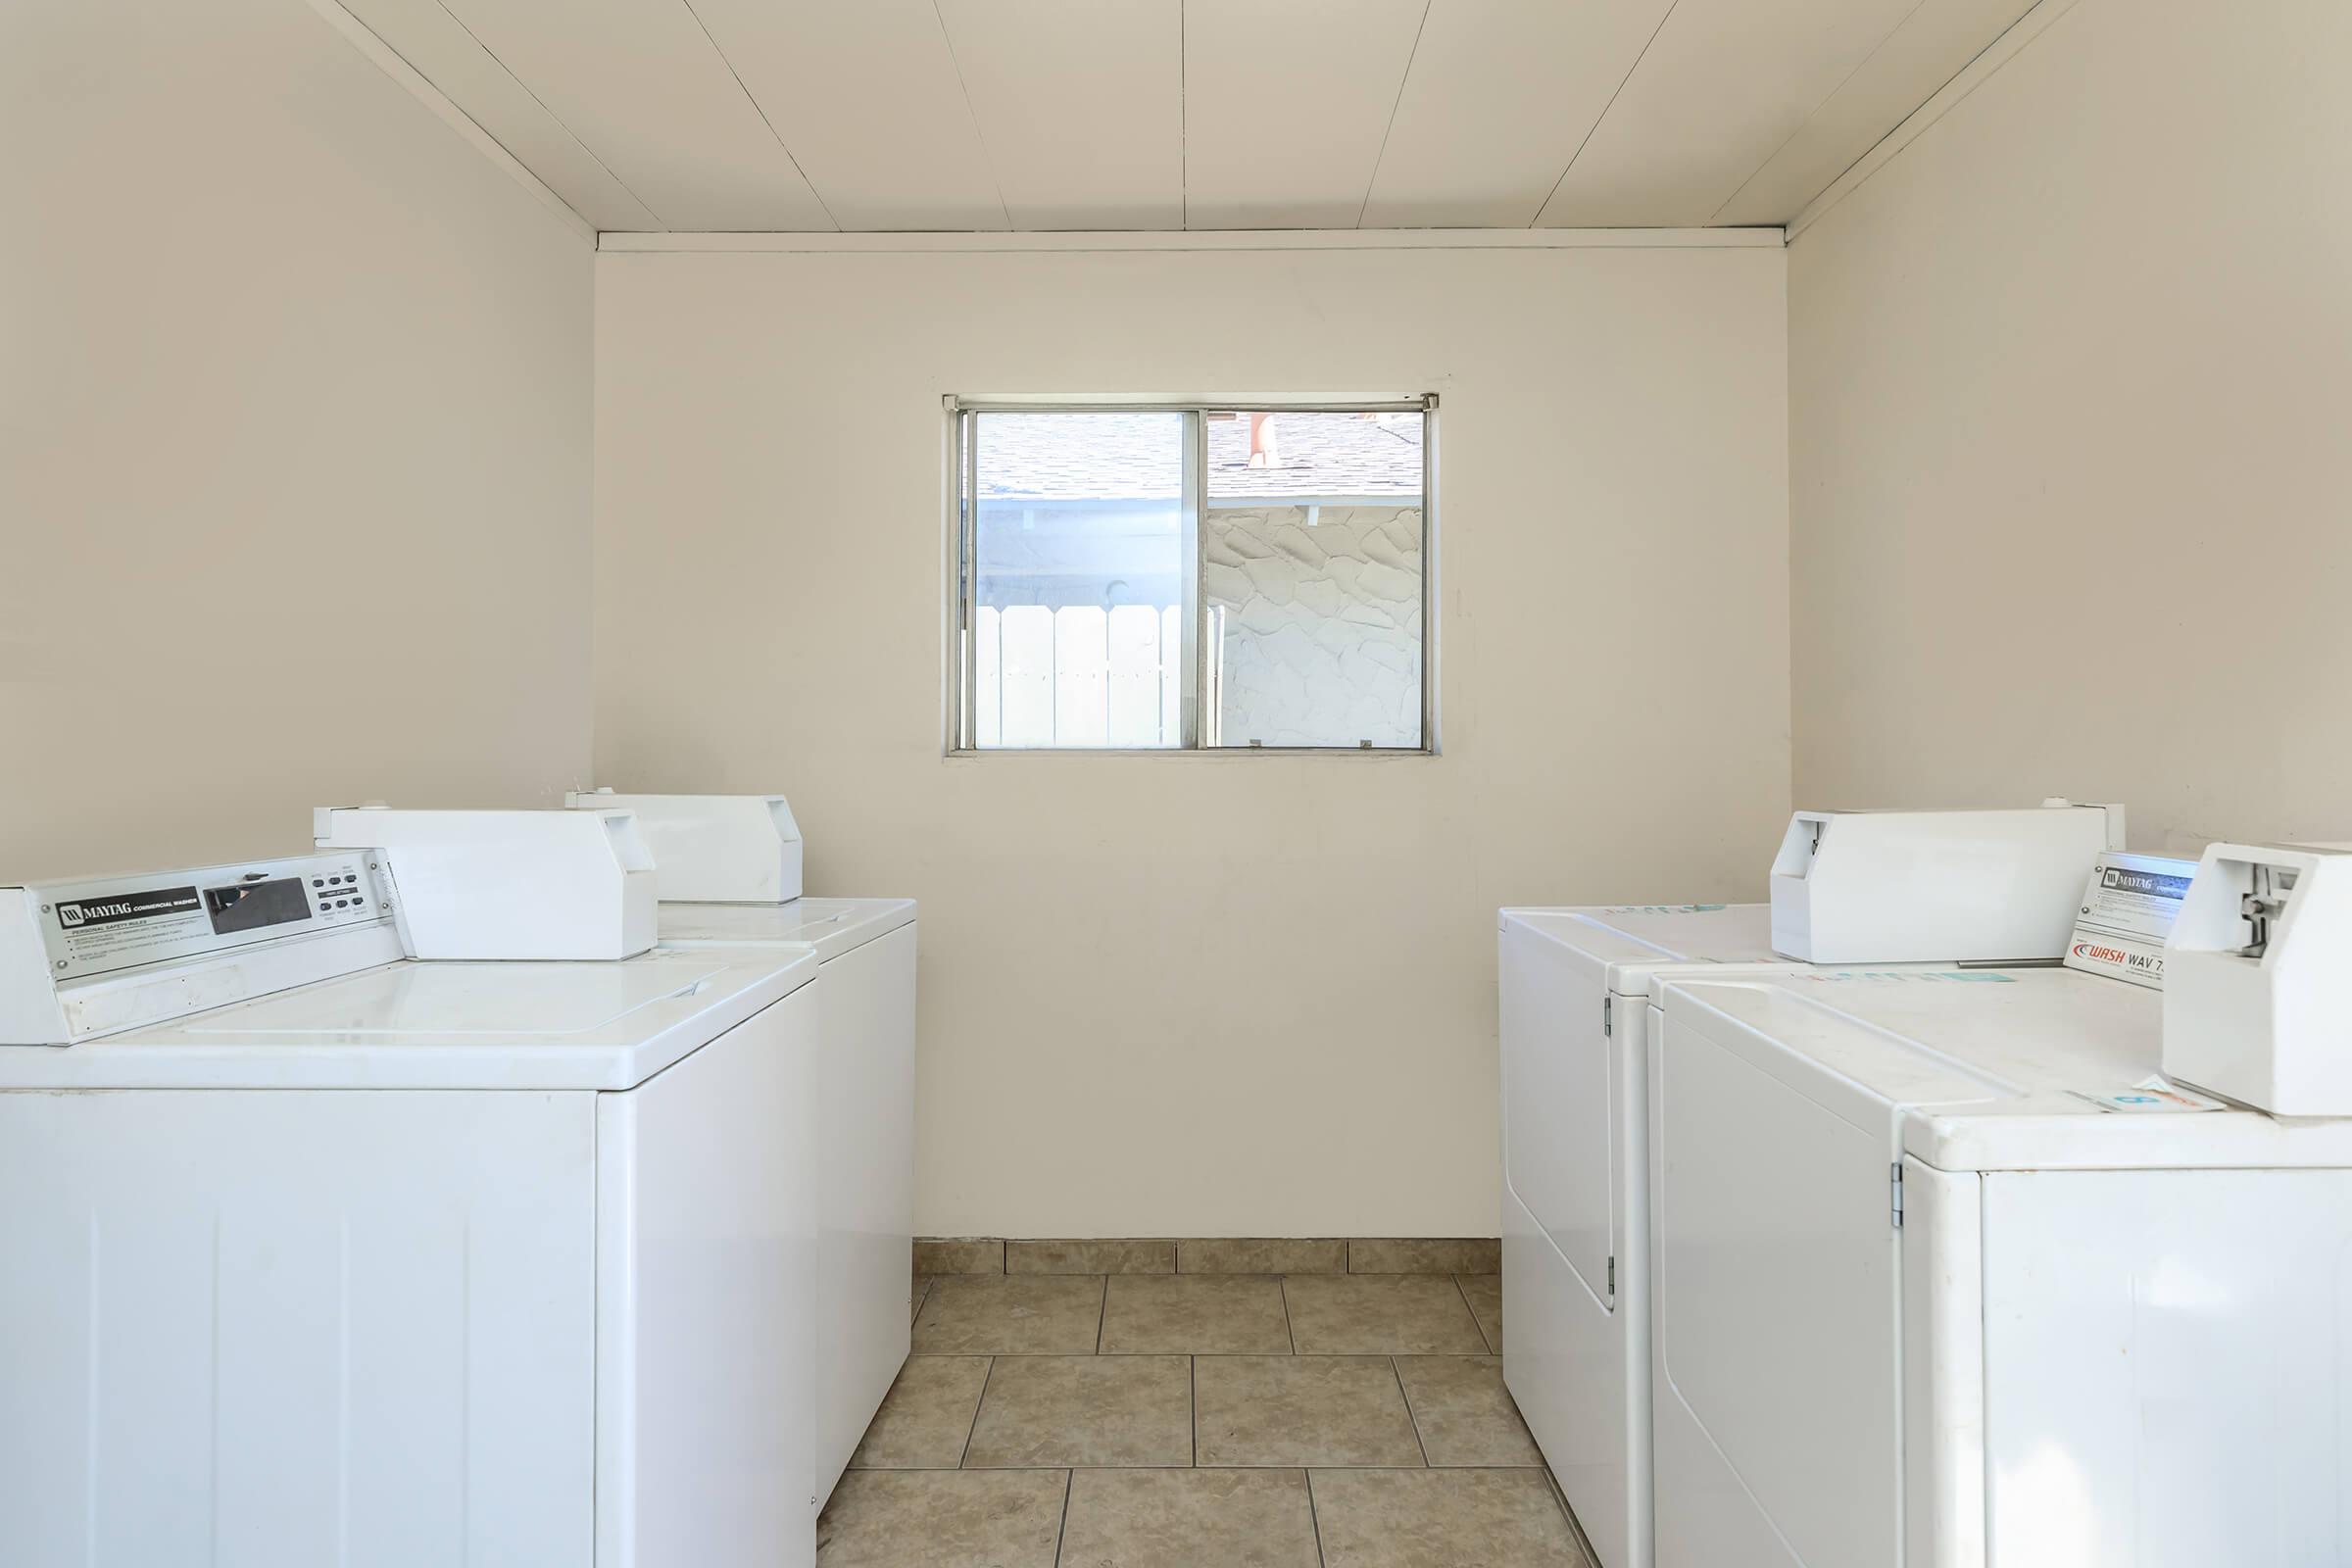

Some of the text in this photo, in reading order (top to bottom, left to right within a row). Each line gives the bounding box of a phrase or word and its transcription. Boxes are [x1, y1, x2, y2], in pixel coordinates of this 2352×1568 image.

[2118, 876, 2153, 889] MAYTAG
[84, 903, 131, 919] MAYTAG
[133, 903, 172, 911] COMMERCIAL
[2088, 946, 2126, 963] WASH
[2129, 954, 2153, 969] WAV
